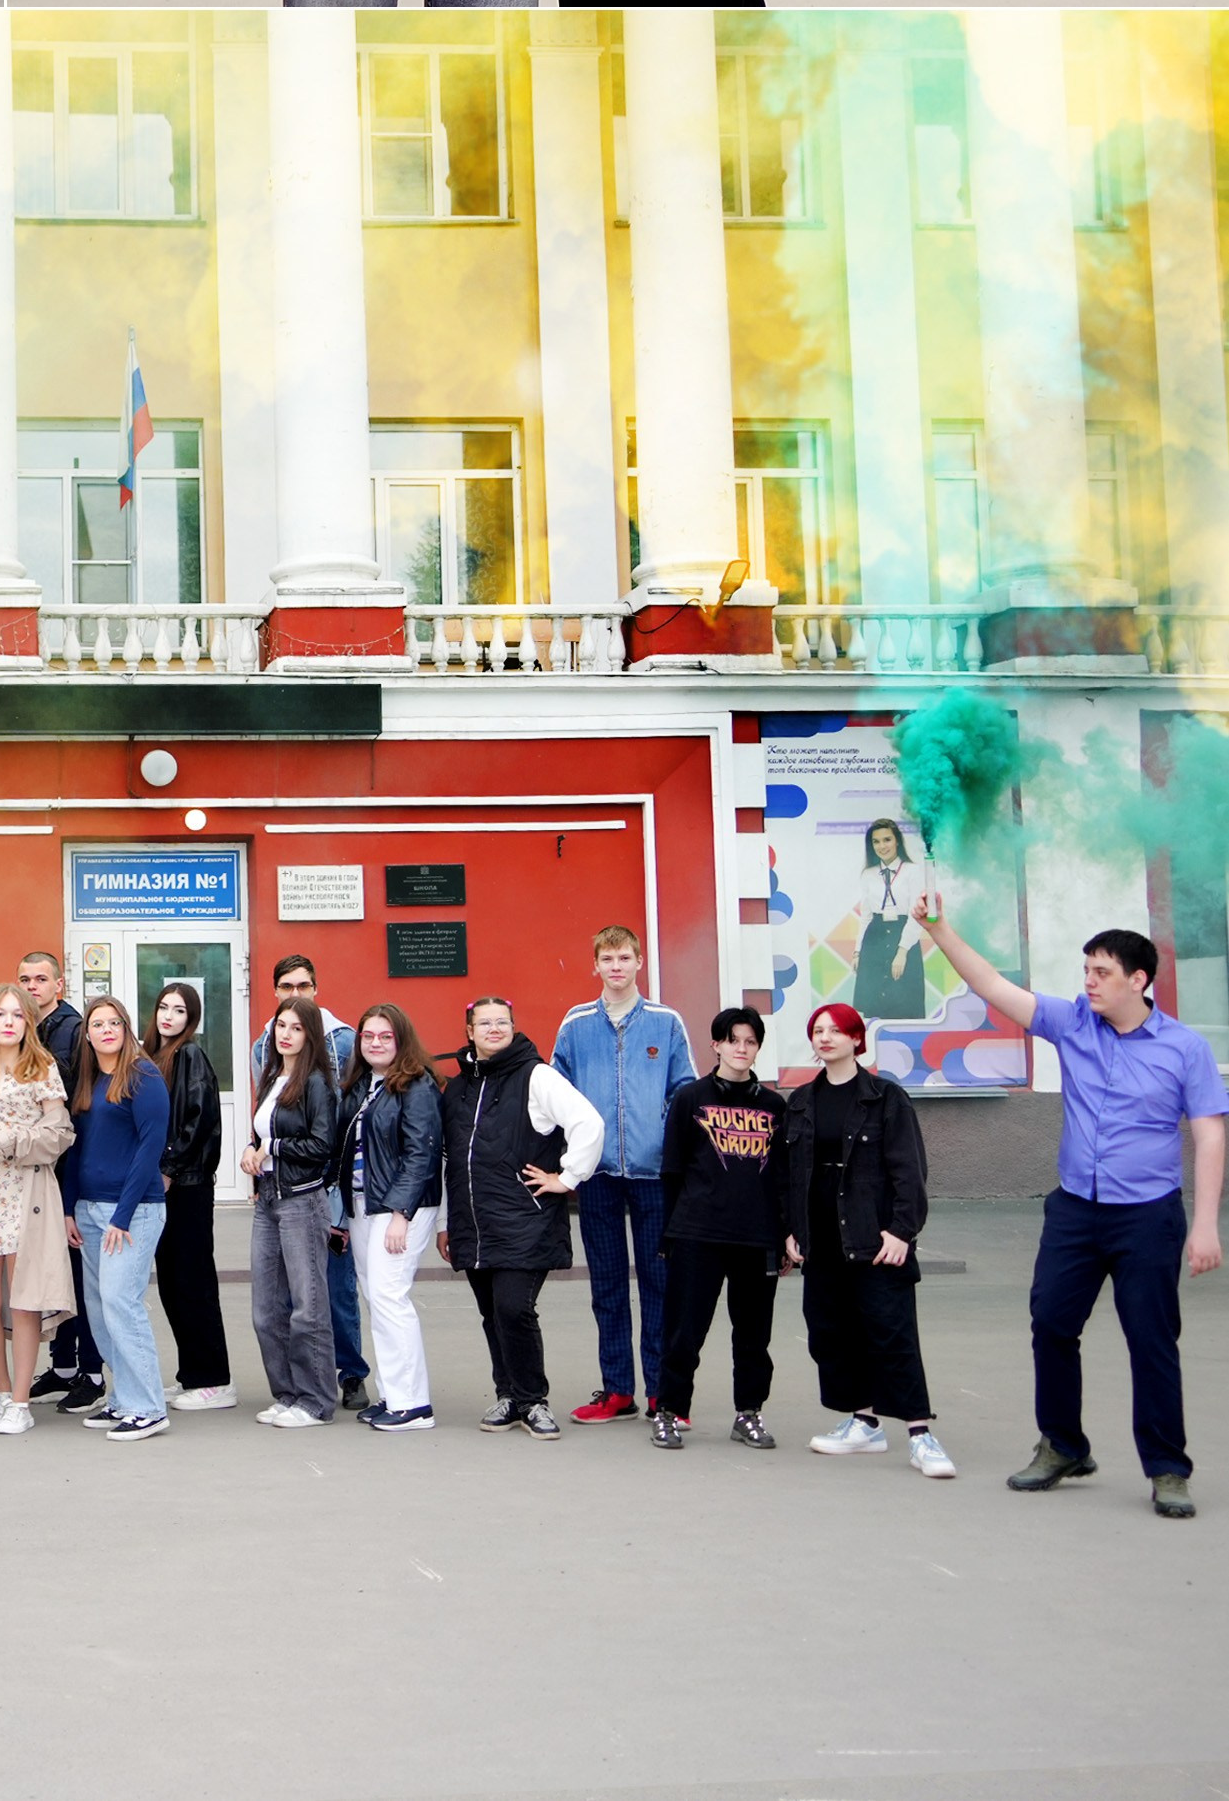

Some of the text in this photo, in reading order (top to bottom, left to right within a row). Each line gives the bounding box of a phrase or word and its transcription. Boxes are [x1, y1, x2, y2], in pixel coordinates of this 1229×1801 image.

[767, 745, 788, 755] Кто
[767, 756, 797, 764] каждое
[798, 756, 838, 764] мгновение
[840, 755, 875, 765] глубоким
[787, 765, 829, 774] бесконечно
[831, 765, 876, 775] продлевает
[83, 873, 228, 890] ГИМНАЗИЯ №1
